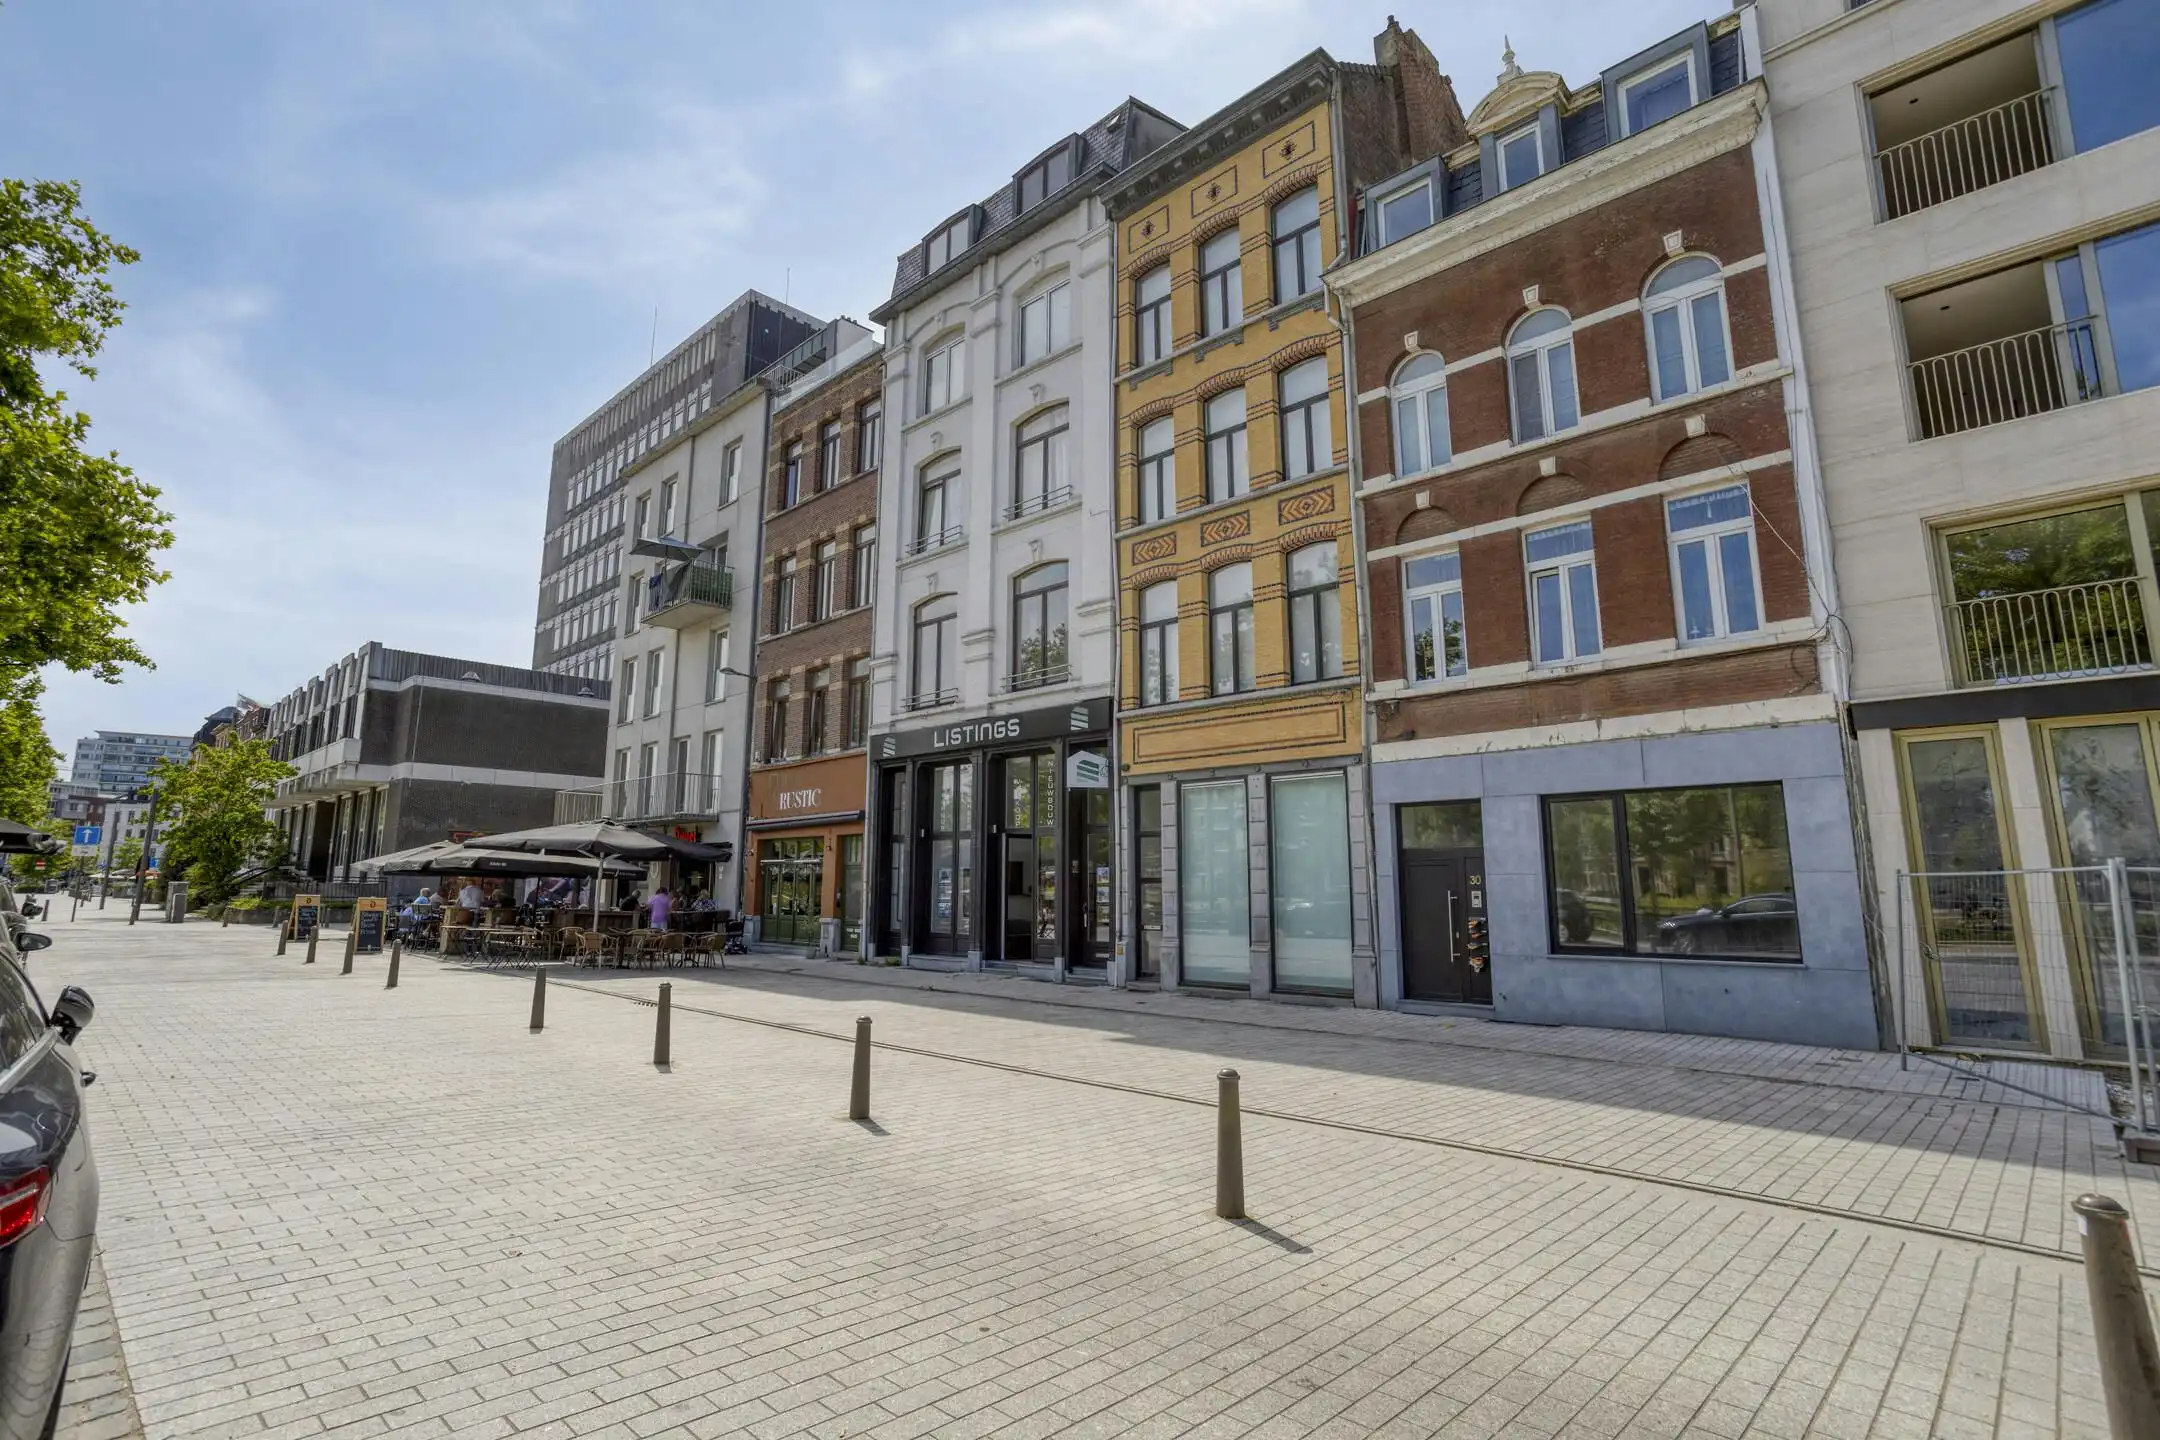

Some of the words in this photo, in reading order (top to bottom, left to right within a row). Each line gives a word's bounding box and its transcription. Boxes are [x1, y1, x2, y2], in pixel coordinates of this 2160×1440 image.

[933, 718, 1020, 748] LISTINGS
[780, 788, 822, 810] RUSTIC
[1470, 874, 1481, 885] 30
